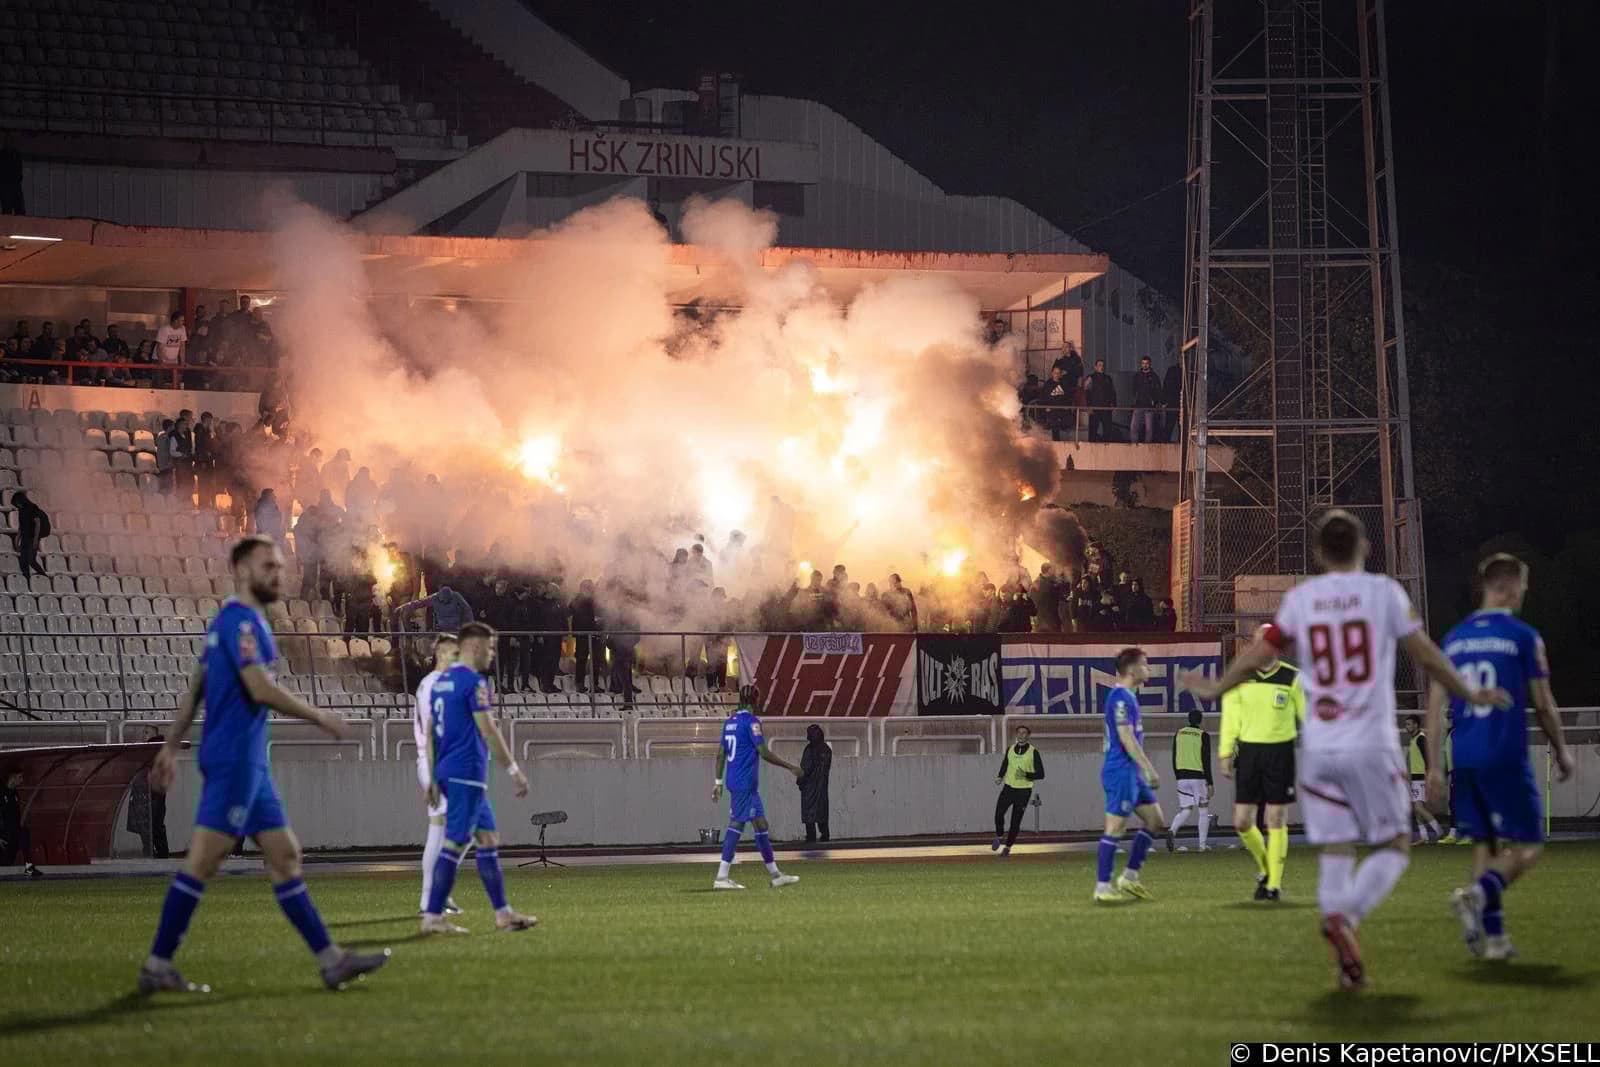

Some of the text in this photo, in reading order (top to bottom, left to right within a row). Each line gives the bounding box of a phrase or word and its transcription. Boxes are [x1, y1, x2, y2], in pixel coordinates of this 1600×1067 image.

[569, 133, 761, 179] HŠK ZRINJSKI
[1308, 621, 1371, 687] 99
